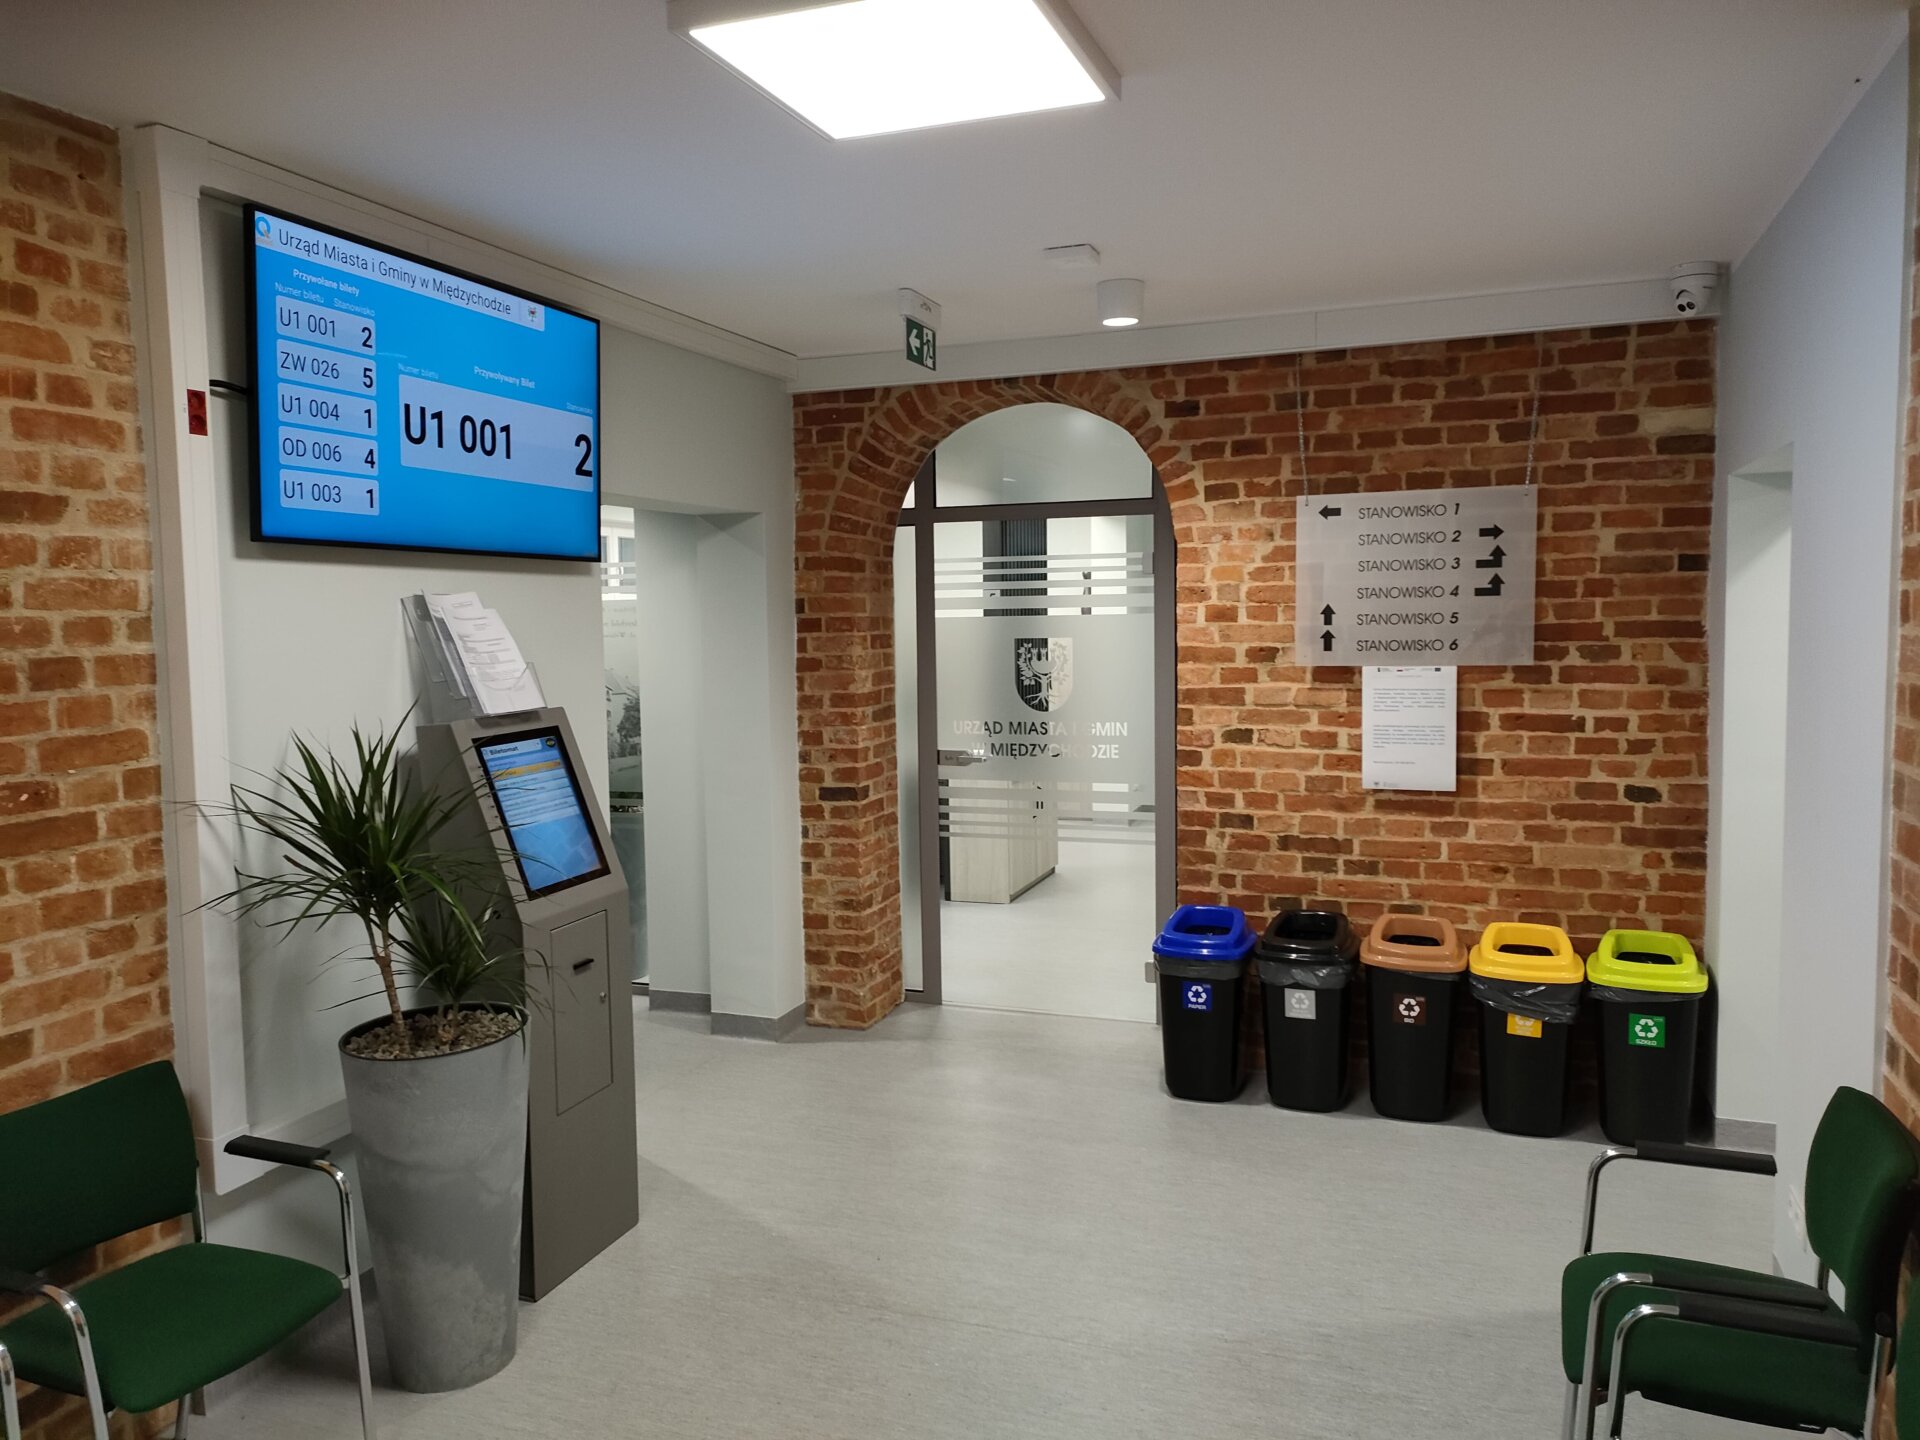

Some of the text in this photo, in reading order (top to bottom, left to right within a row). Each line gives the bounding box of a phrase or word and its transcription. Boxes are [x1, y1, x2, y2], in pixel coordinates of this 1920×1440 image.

[279, 229, 511, 315] Urząd Miasta i Gminy w Międzychodzie
[280, 307, 335, 338] U1 001
[361, 326, 373, 349] 2
[280, 351, 340, 379] ZW 026
[363, 367, 374, 389] 5
[281, 394, 340, 421] U1 004
[364, 408, 372, 429] 1
[404, 403, 511, 460] U1 001
[282, 437, 342, 462] OD 006
[364, 448, 376, 469] 4
[574, 433, 593, 478] 2
[283, 480, 341, 503] U1 003
[366, 488, 374, 509] 1
[1358, 503, 1460, 520] STANOWISKO 1
[1358, 529, 1462, 546] STANOWISKO 2
[1358, 557, 1461, 572] STANOWISKO 3
[1357, 584, 1460, 600] STANOWISKO 4
[1356, 611, 1460, 626] STANOWISKO 5
[1356, 638, 1459, 652] STANOWISKO 6
[953, 720, 1004, 738] URZĄD
[1008, 720, 1067, 736] MIASTA
